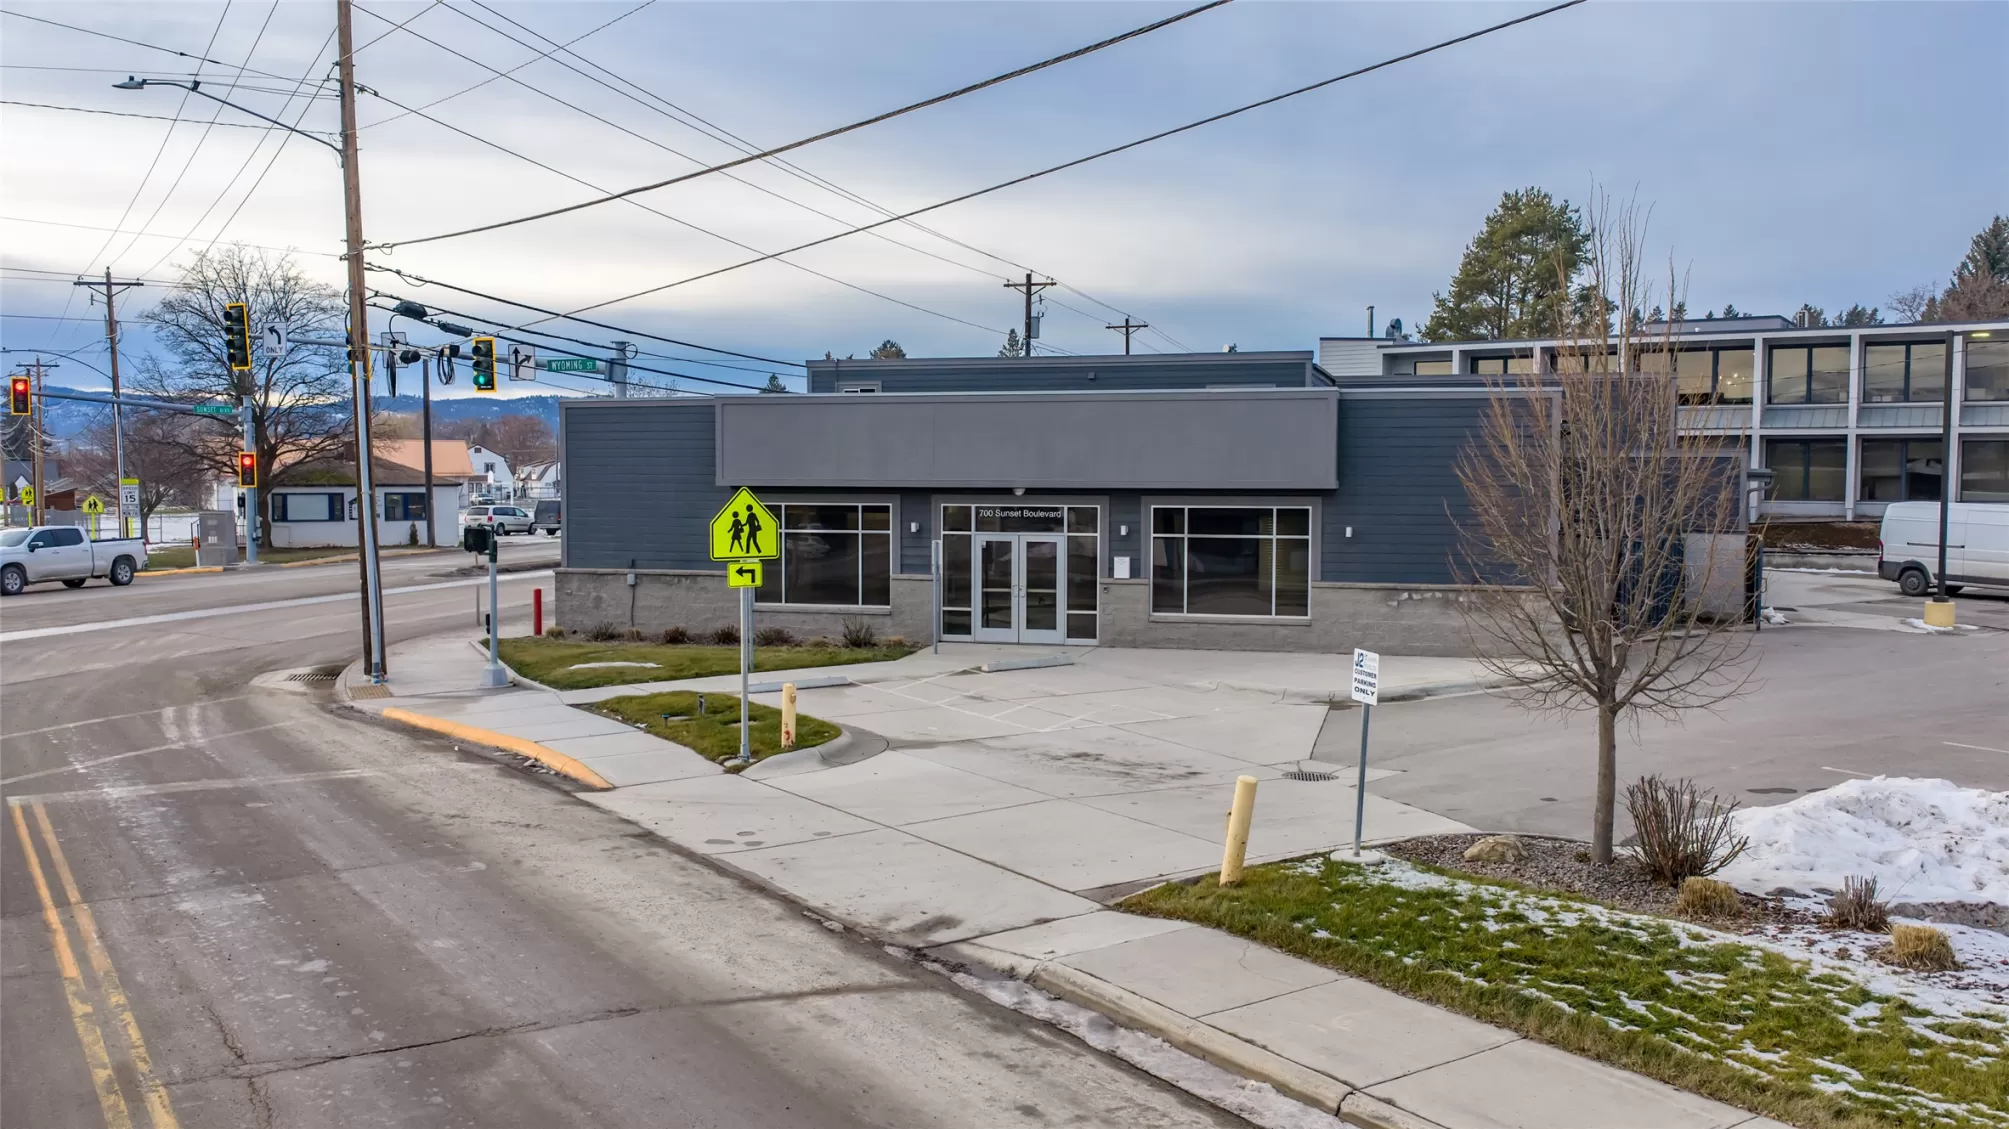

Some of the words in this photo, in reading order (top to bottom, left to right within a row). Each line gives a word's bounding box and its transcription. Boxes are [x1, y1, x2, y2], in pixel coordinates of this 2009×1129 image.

[266, 346, 283, 354] ONLY
[551, 360, 583, 370] WYOMING
[586, 361, 593, 369] ST
[125, 494, 136, 503] 15
[979, 509, 994, 517] 700
[995, 509, 1021, 518] Sunset
[1023, 510, 1062, 518] Boulevard
[1355, 652, 1364, 668] J2
[1355, 668, 1377, 679] CUSTOMER
[1354, 677, 1376, 688] PARKING
[1354, 686, 1375, 697] ONLY
